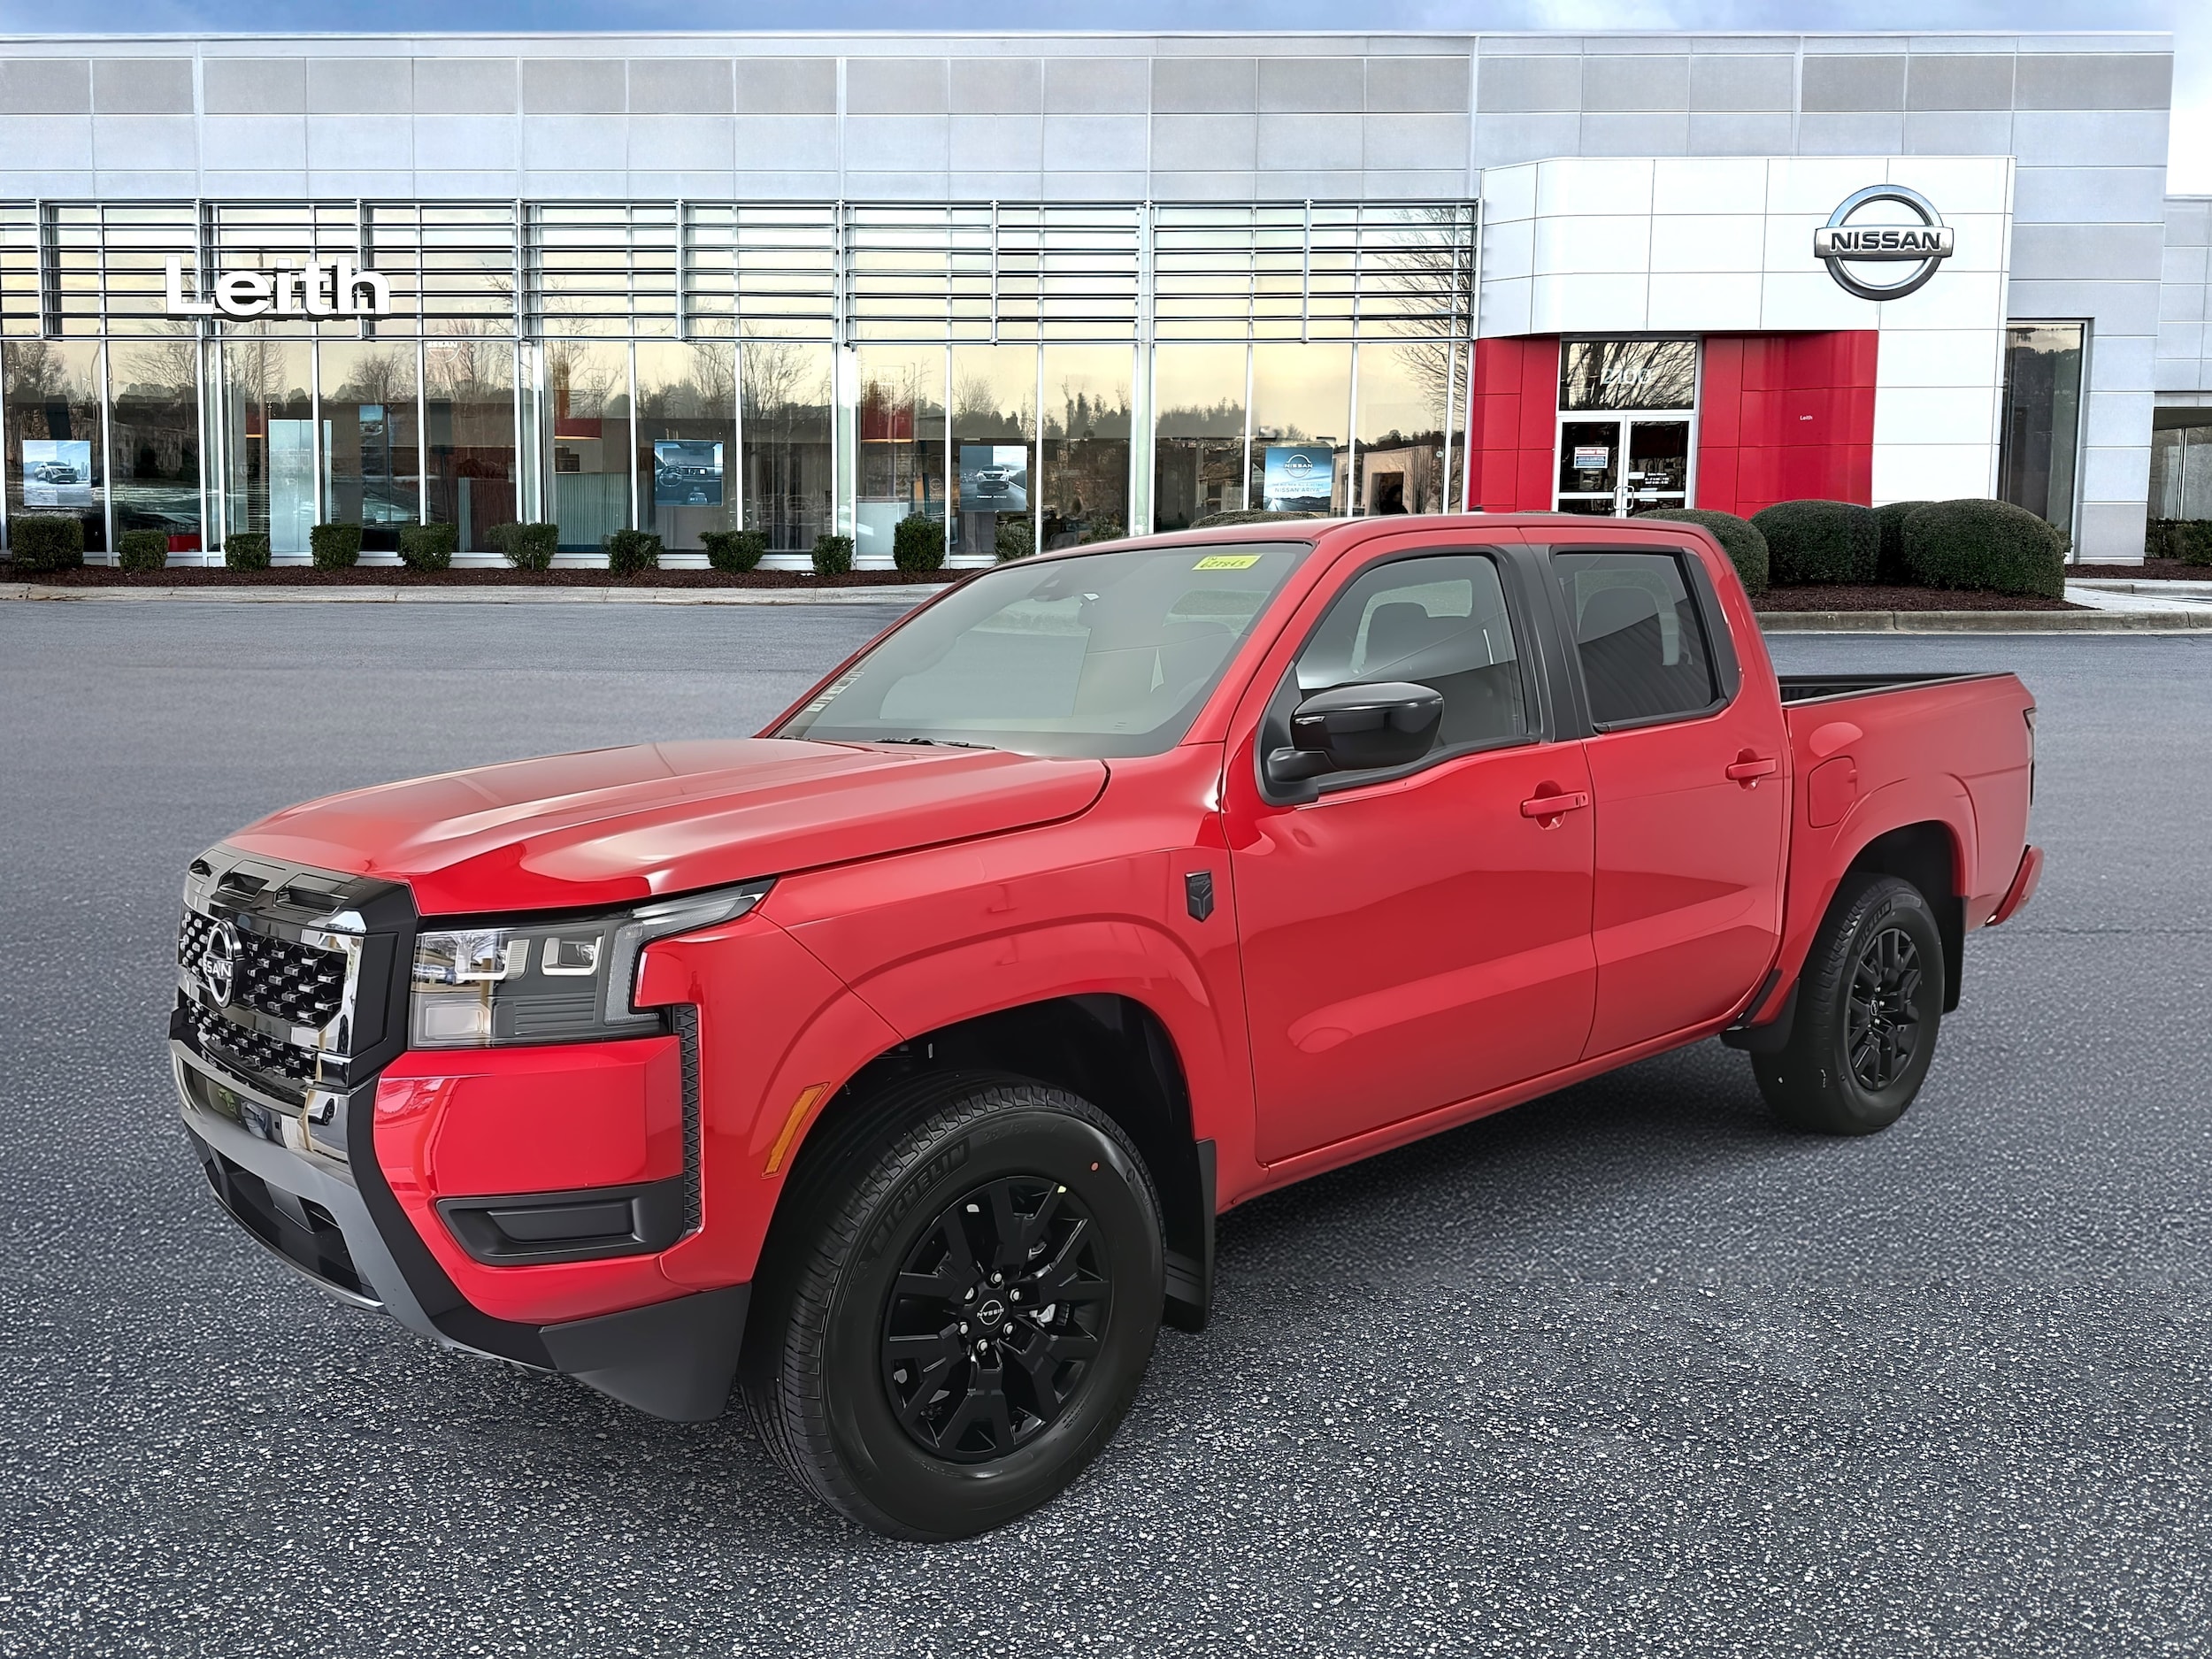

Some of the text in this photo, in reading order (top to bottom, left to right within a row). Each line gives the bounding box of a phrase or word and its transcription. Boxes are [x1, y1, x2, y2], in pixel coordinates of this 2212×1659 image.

[1831, 231, 1941, 251] NISSAN
[165, 256, 391, 317] Leith
[872, 1142, 966, 1253] MICHELIN
[977, 1308, 1004, 1317] NISSAN
